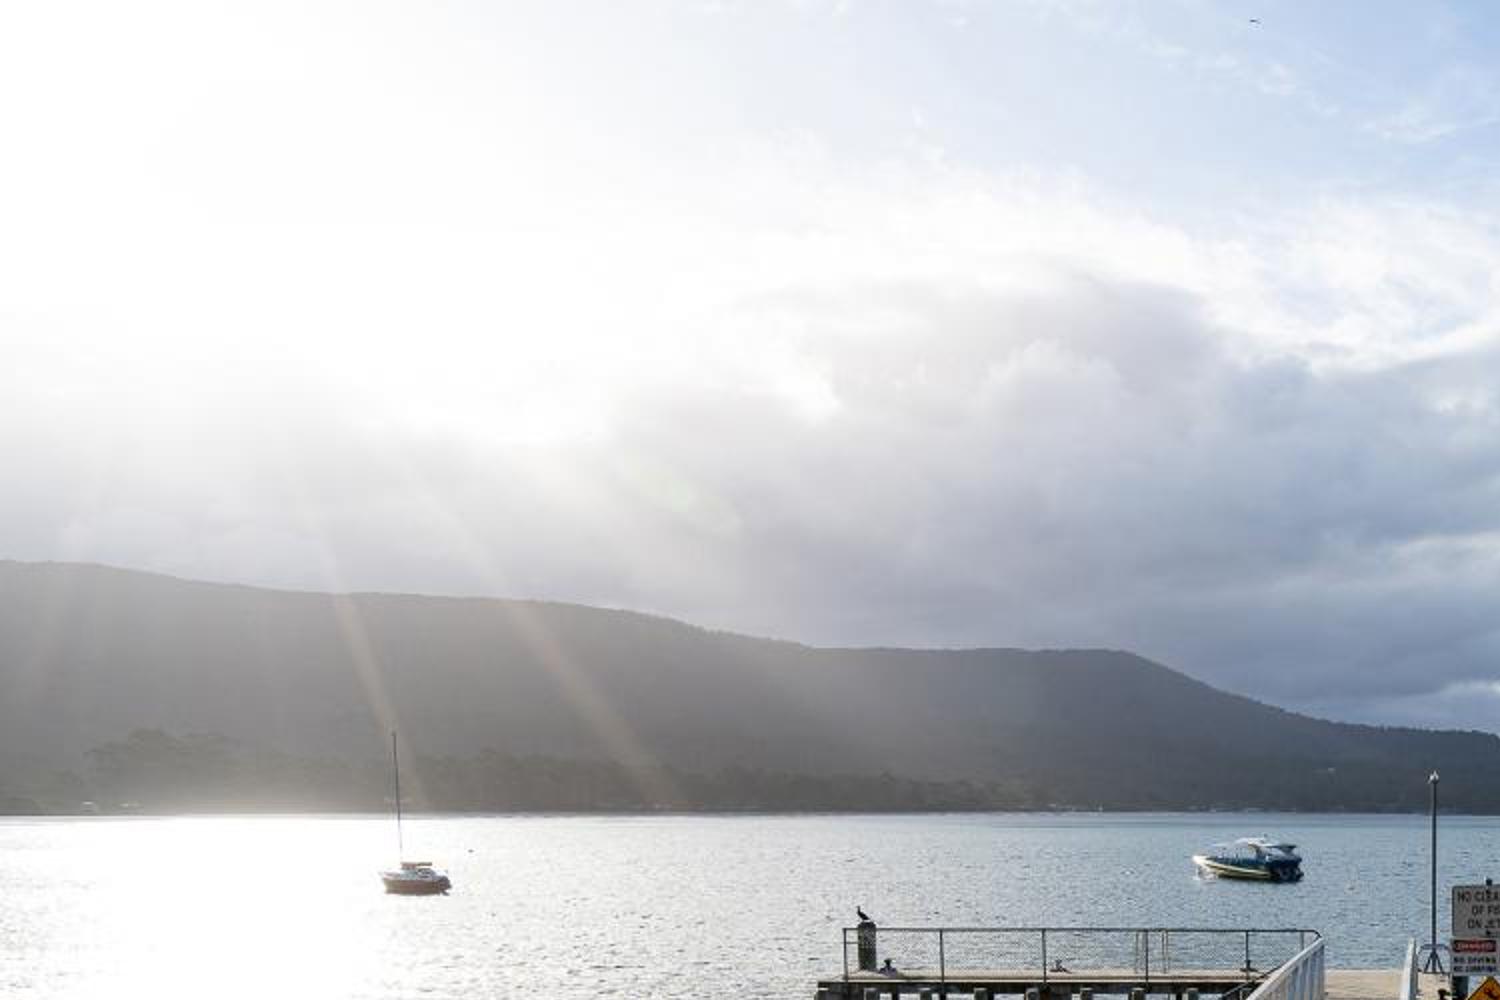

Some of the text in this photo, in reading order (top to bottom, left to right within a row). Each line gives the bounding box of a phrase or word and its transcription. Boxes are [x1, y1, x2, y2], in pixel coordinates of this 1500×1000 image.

[1457, 891, 1472, 903] NO
[1472, 905, 1485, 916] OF
[1468, 918, 1482, 928] ON
